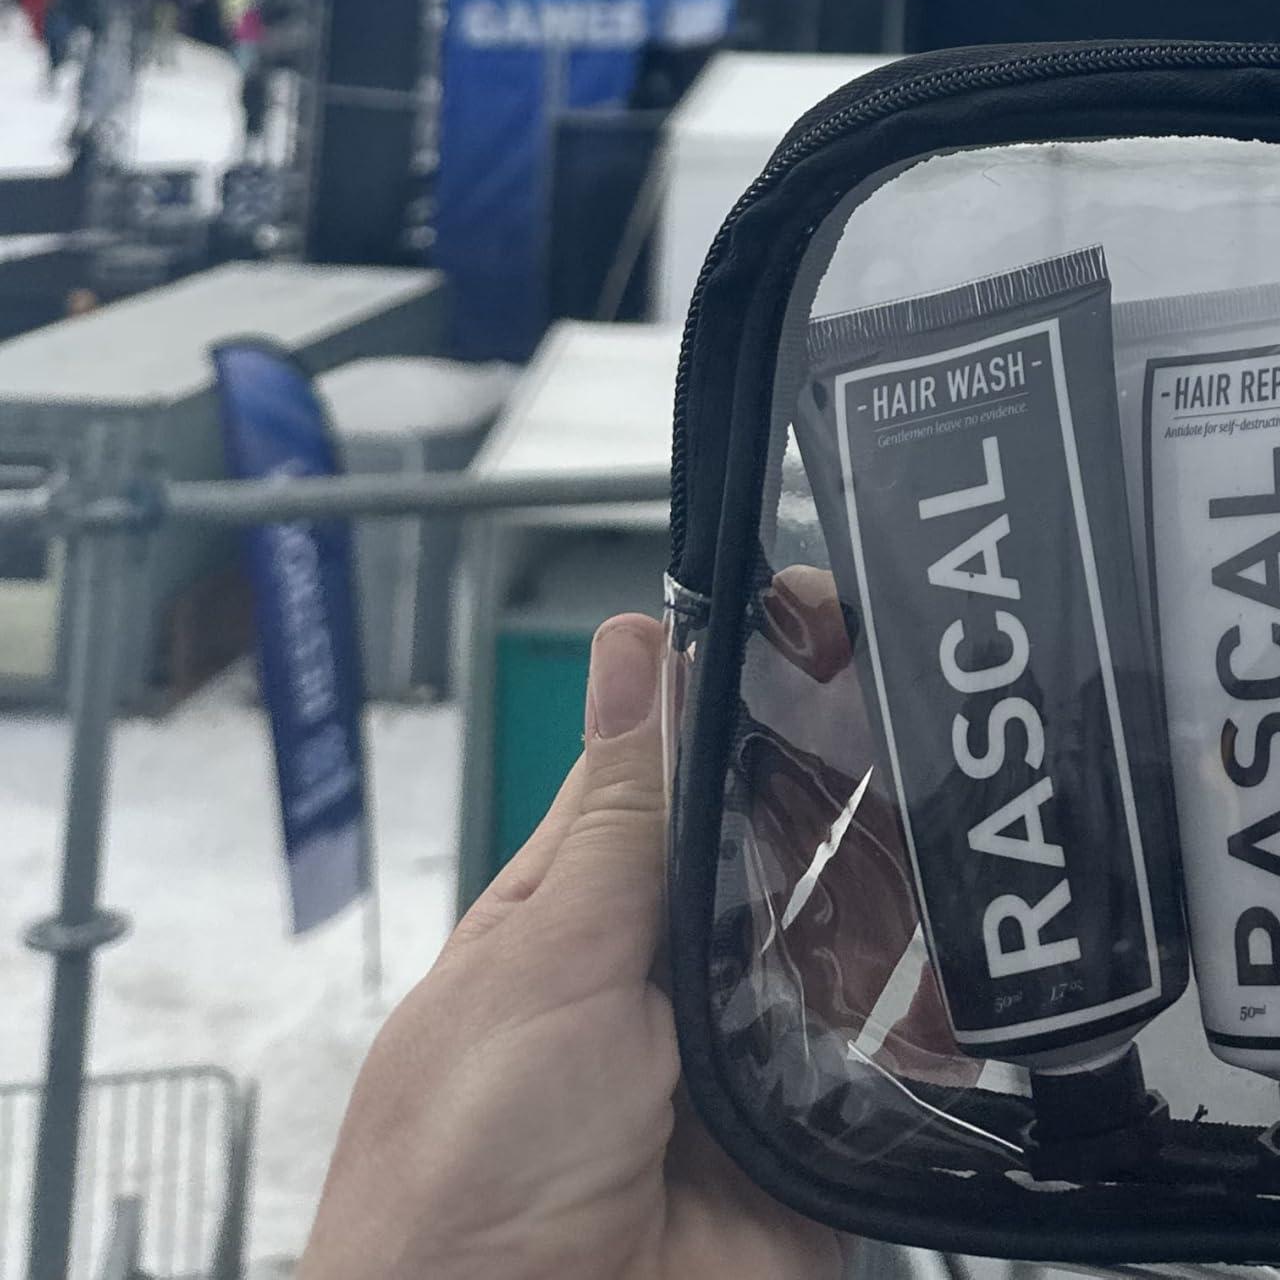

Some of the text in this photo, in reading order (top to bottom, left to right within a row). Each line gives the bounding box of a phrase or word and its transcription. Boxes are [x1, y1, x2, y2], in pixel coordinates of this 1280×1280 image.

[1164, 422, 1203, 439] Antidote
[1203, 421, 1217, 438] for
[918, 436, 1082, 978] RASCAL
